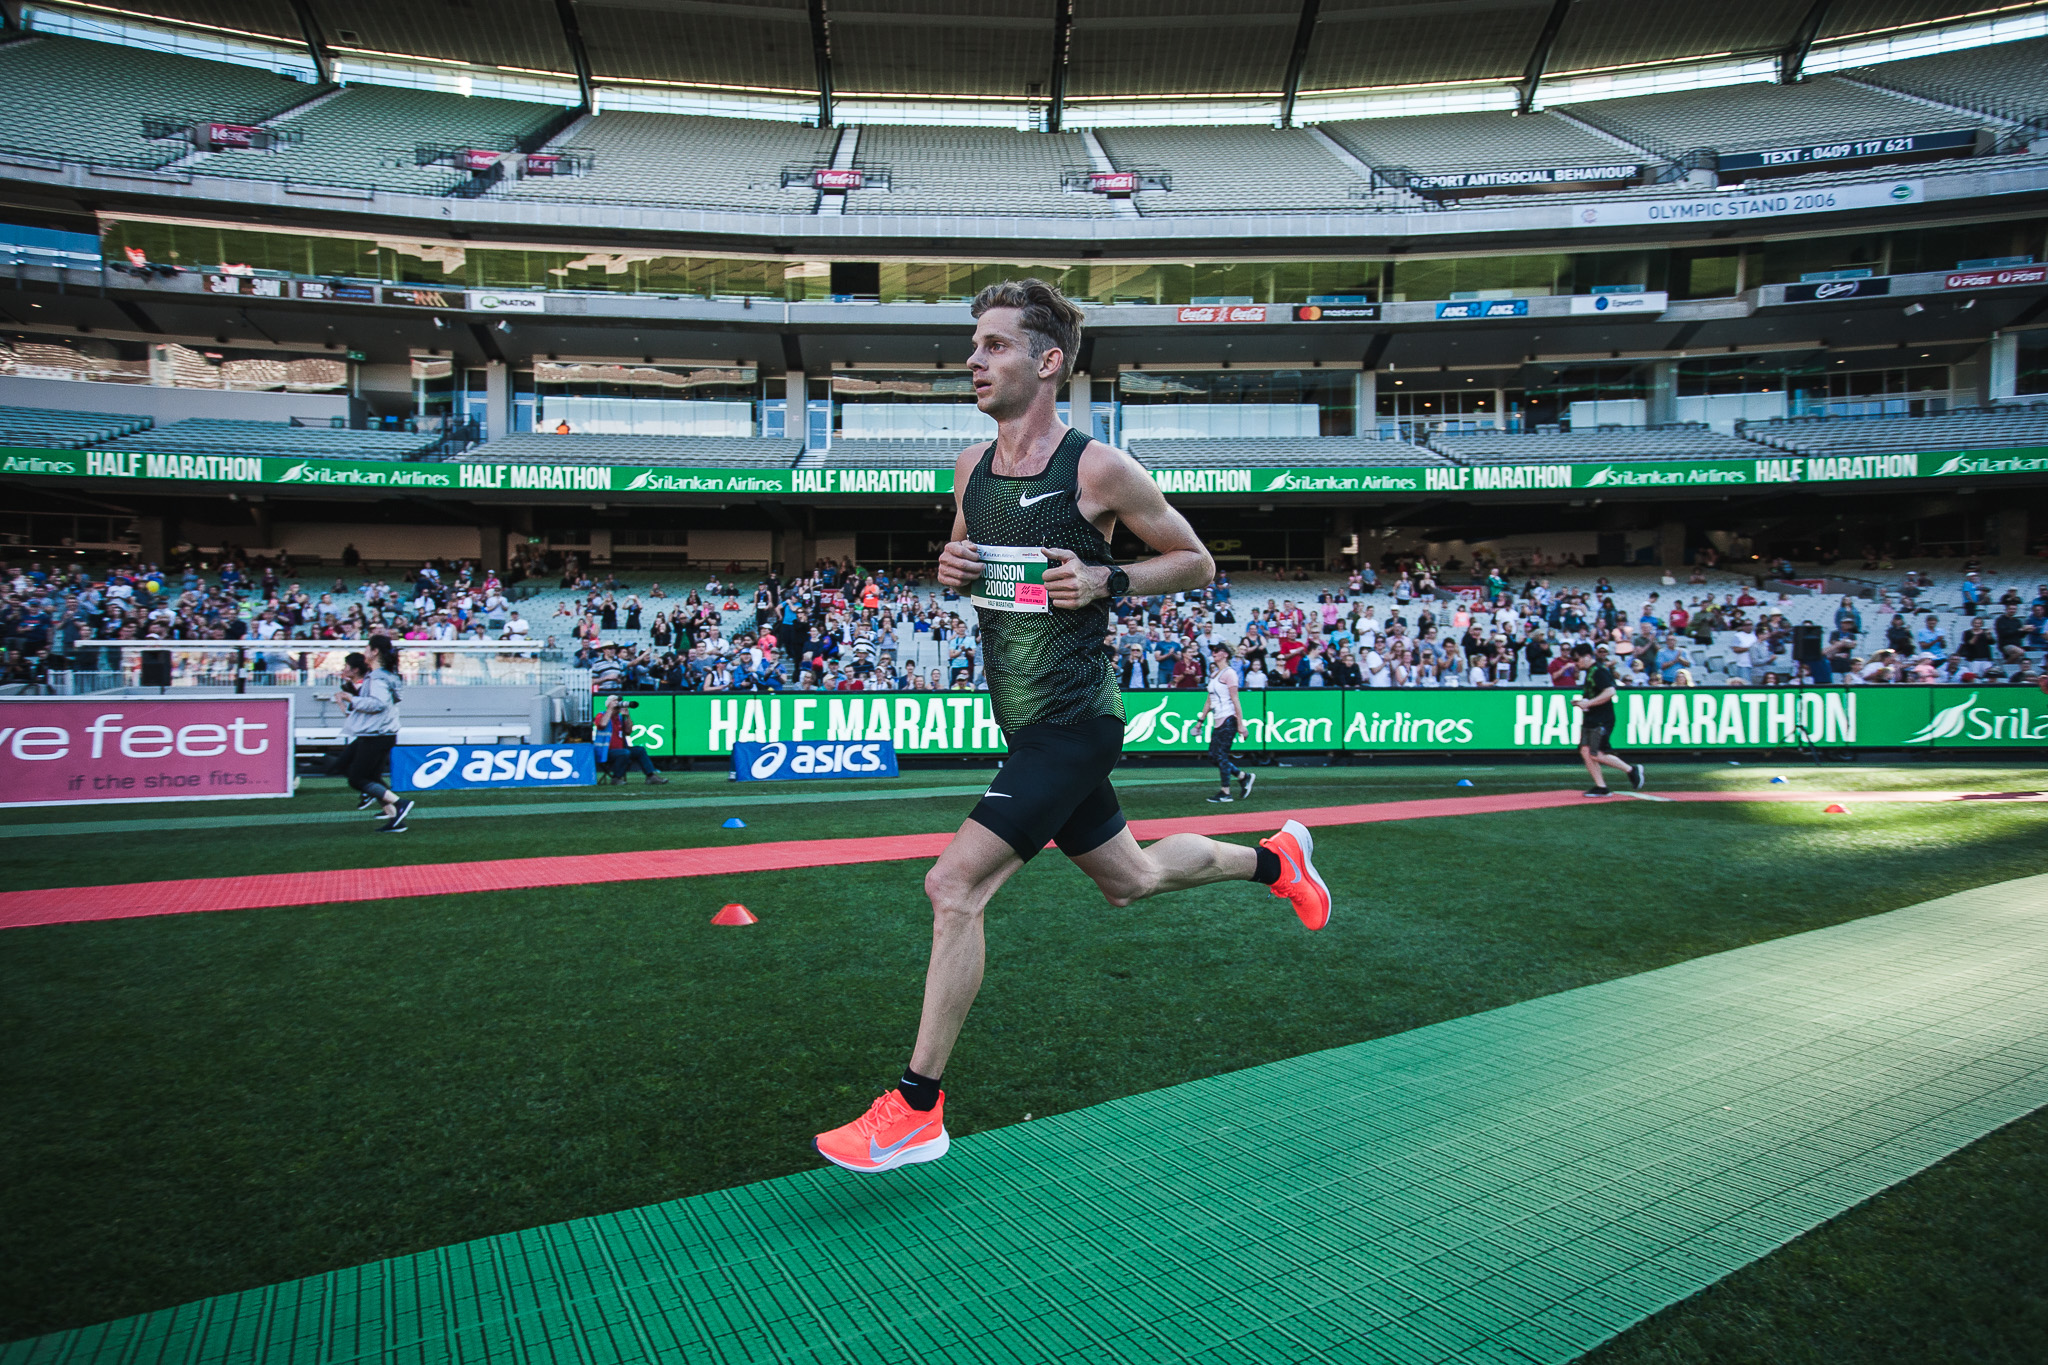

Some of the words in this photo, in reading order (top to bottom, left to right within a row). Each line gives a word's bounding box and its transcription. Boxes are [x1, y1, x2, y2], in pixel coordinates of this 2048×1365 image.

[1761, 149, 1801, 164] TEXT
[1813, 144, 1852, 160] 0409
[1854, 141, 1882, 155] 117
[1884, 137, 1914, 152] 621
[1467, 169, 1552, 186] ANTISOCIAL
[1554, 165, 1637, 181] BEHAVIOUR
[1649, 203, 1723, 220] OLYMPIC
[1728, 198, 1788, 214] STAND
[1793, 193, 1837, 210] 2006
[1961, 276, 1994, 286] POST
[2011, 271, 2044, 281] POST
[1323, 308, 1374, 317] mastercard
[1441, 306, 1468, 318] ANZ
[1487, 304, 1514, 317] ANZ
[3, 456, 76, 473] Airlines
[87, 452, 143, 477] HALF
[147, 454, 262, 481] MARATHON
[303, 466, 386, 485] SriLankan
[389, 470, 450, 486] Airlines
[459, 465, 507, 488] HALF
[511, 466, 611, 490] MARATHON
[1156, 470, 1251, 492] MARATHON
[1286, 475, 1359, 490] SriLankan
[1361, 475, 1417, 490] Airlines
[1425, 468, 1470, 490] HALF
[1473, 466, 1572, 489] MARATHON
[1608, 470, 1684, 485] SriLankan
[1687, 468, 1747, 483] Airlines
[1756, 460, 1804, 482] HALF
[1807, 455, 1918, 480] MARATHON
[1959, 456, 2048, 473] SriLankan
[648, 474, 723, 490] SriLankan
[727, 475, 783, 491] Airlines
[792, 470, 836, 492] HALF
[840, 470, 936, 492] MARATHON
[983, 563, 1025, 581] OBINSON
[986, 580, 1015, 598] 20008
[827, 698, 1008, 749] MARATH
[1157, 711, 1333, 744] SriLnkan
[1345, 711, 1474, 743] Airlines
[1628, 692, 1855, 744] MARATHON
[0, 726, 70, 760] e
[85, 714, 270, 758] feet
[462, 749, 574, 781] asics
[791, 744, 880, 773] asics
[67, 775, 85, 790] if
[93, 773, 134, 789] the
[144, 771, 200, 787] shoe
